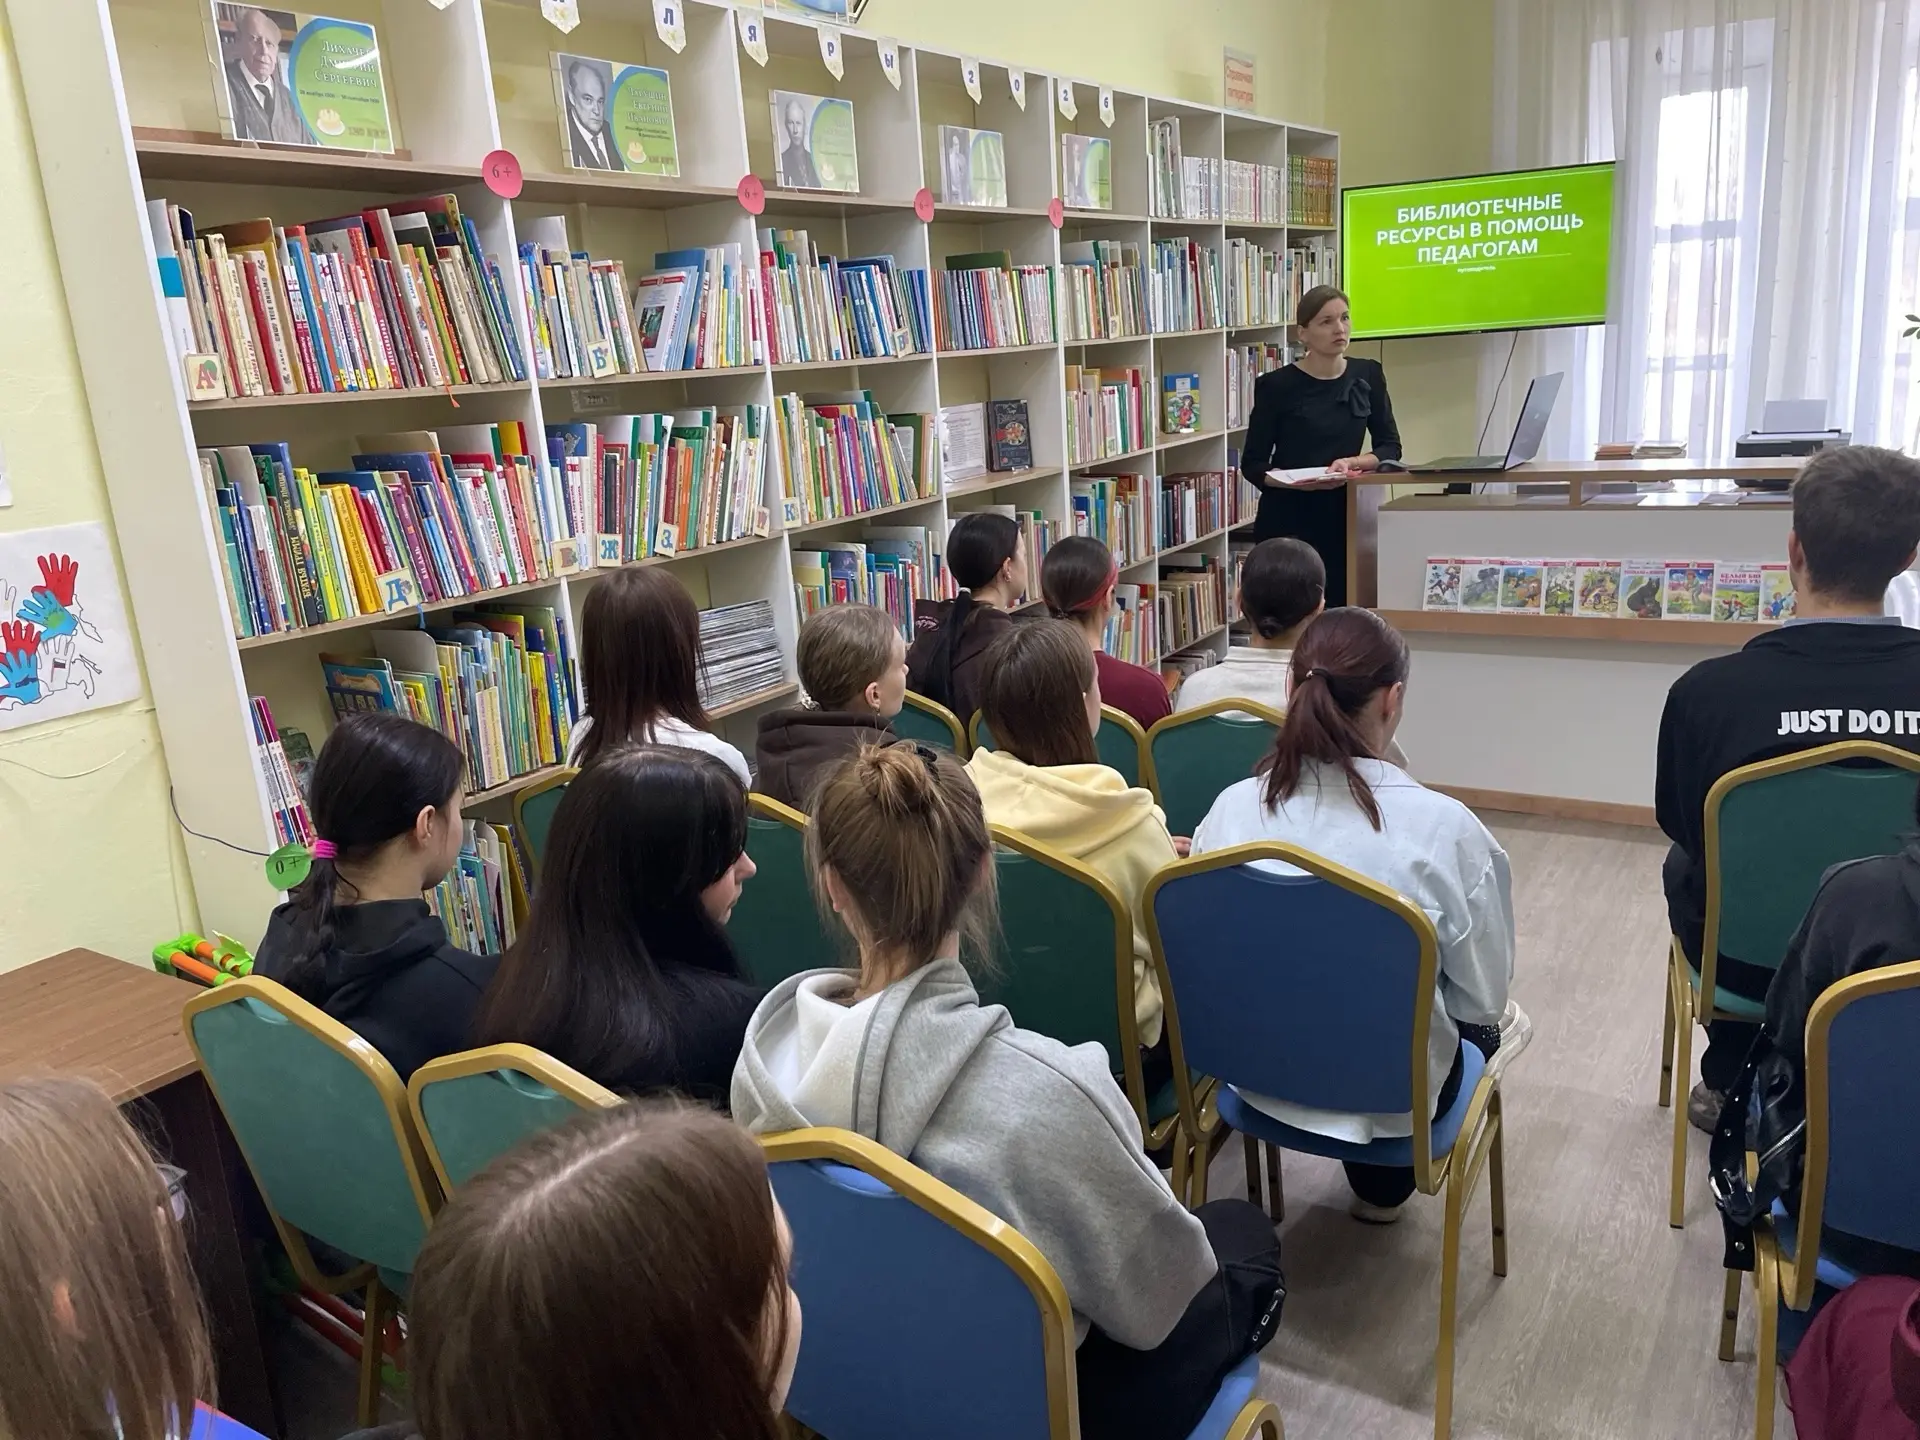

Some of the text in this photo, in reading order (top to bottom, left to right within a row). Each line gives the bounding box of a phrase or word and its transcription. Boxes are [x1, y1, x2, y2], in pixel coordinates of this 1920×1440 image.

[322, 41, 374, 56] ЛИХАЧЕ
[320, 56, 376, 73] ДМРИЙ
[1397, 193, 1563, 224] БИБЛИОТЕЧНЫЕ
[1377, 213, 1584, 246] РЕСУРСЫ В ПОМОЩЬ
[1417, 238, 1538, 264] ПЕДАГОГАМ
[196, 363, 215, 390] А
[784, 501, 795, 521] К
[289, 534, 305, 566] ГРИММ
[601, 539, 618, 561] Ж
[296, 565, 312, 599] БРАТЬЯ
[387, 577, 409, 608] Д
[1777, 709, 1843, 735] JUST
[1848, 709, 1891, 734] DO
[275, 855, 300, 875] 0+
